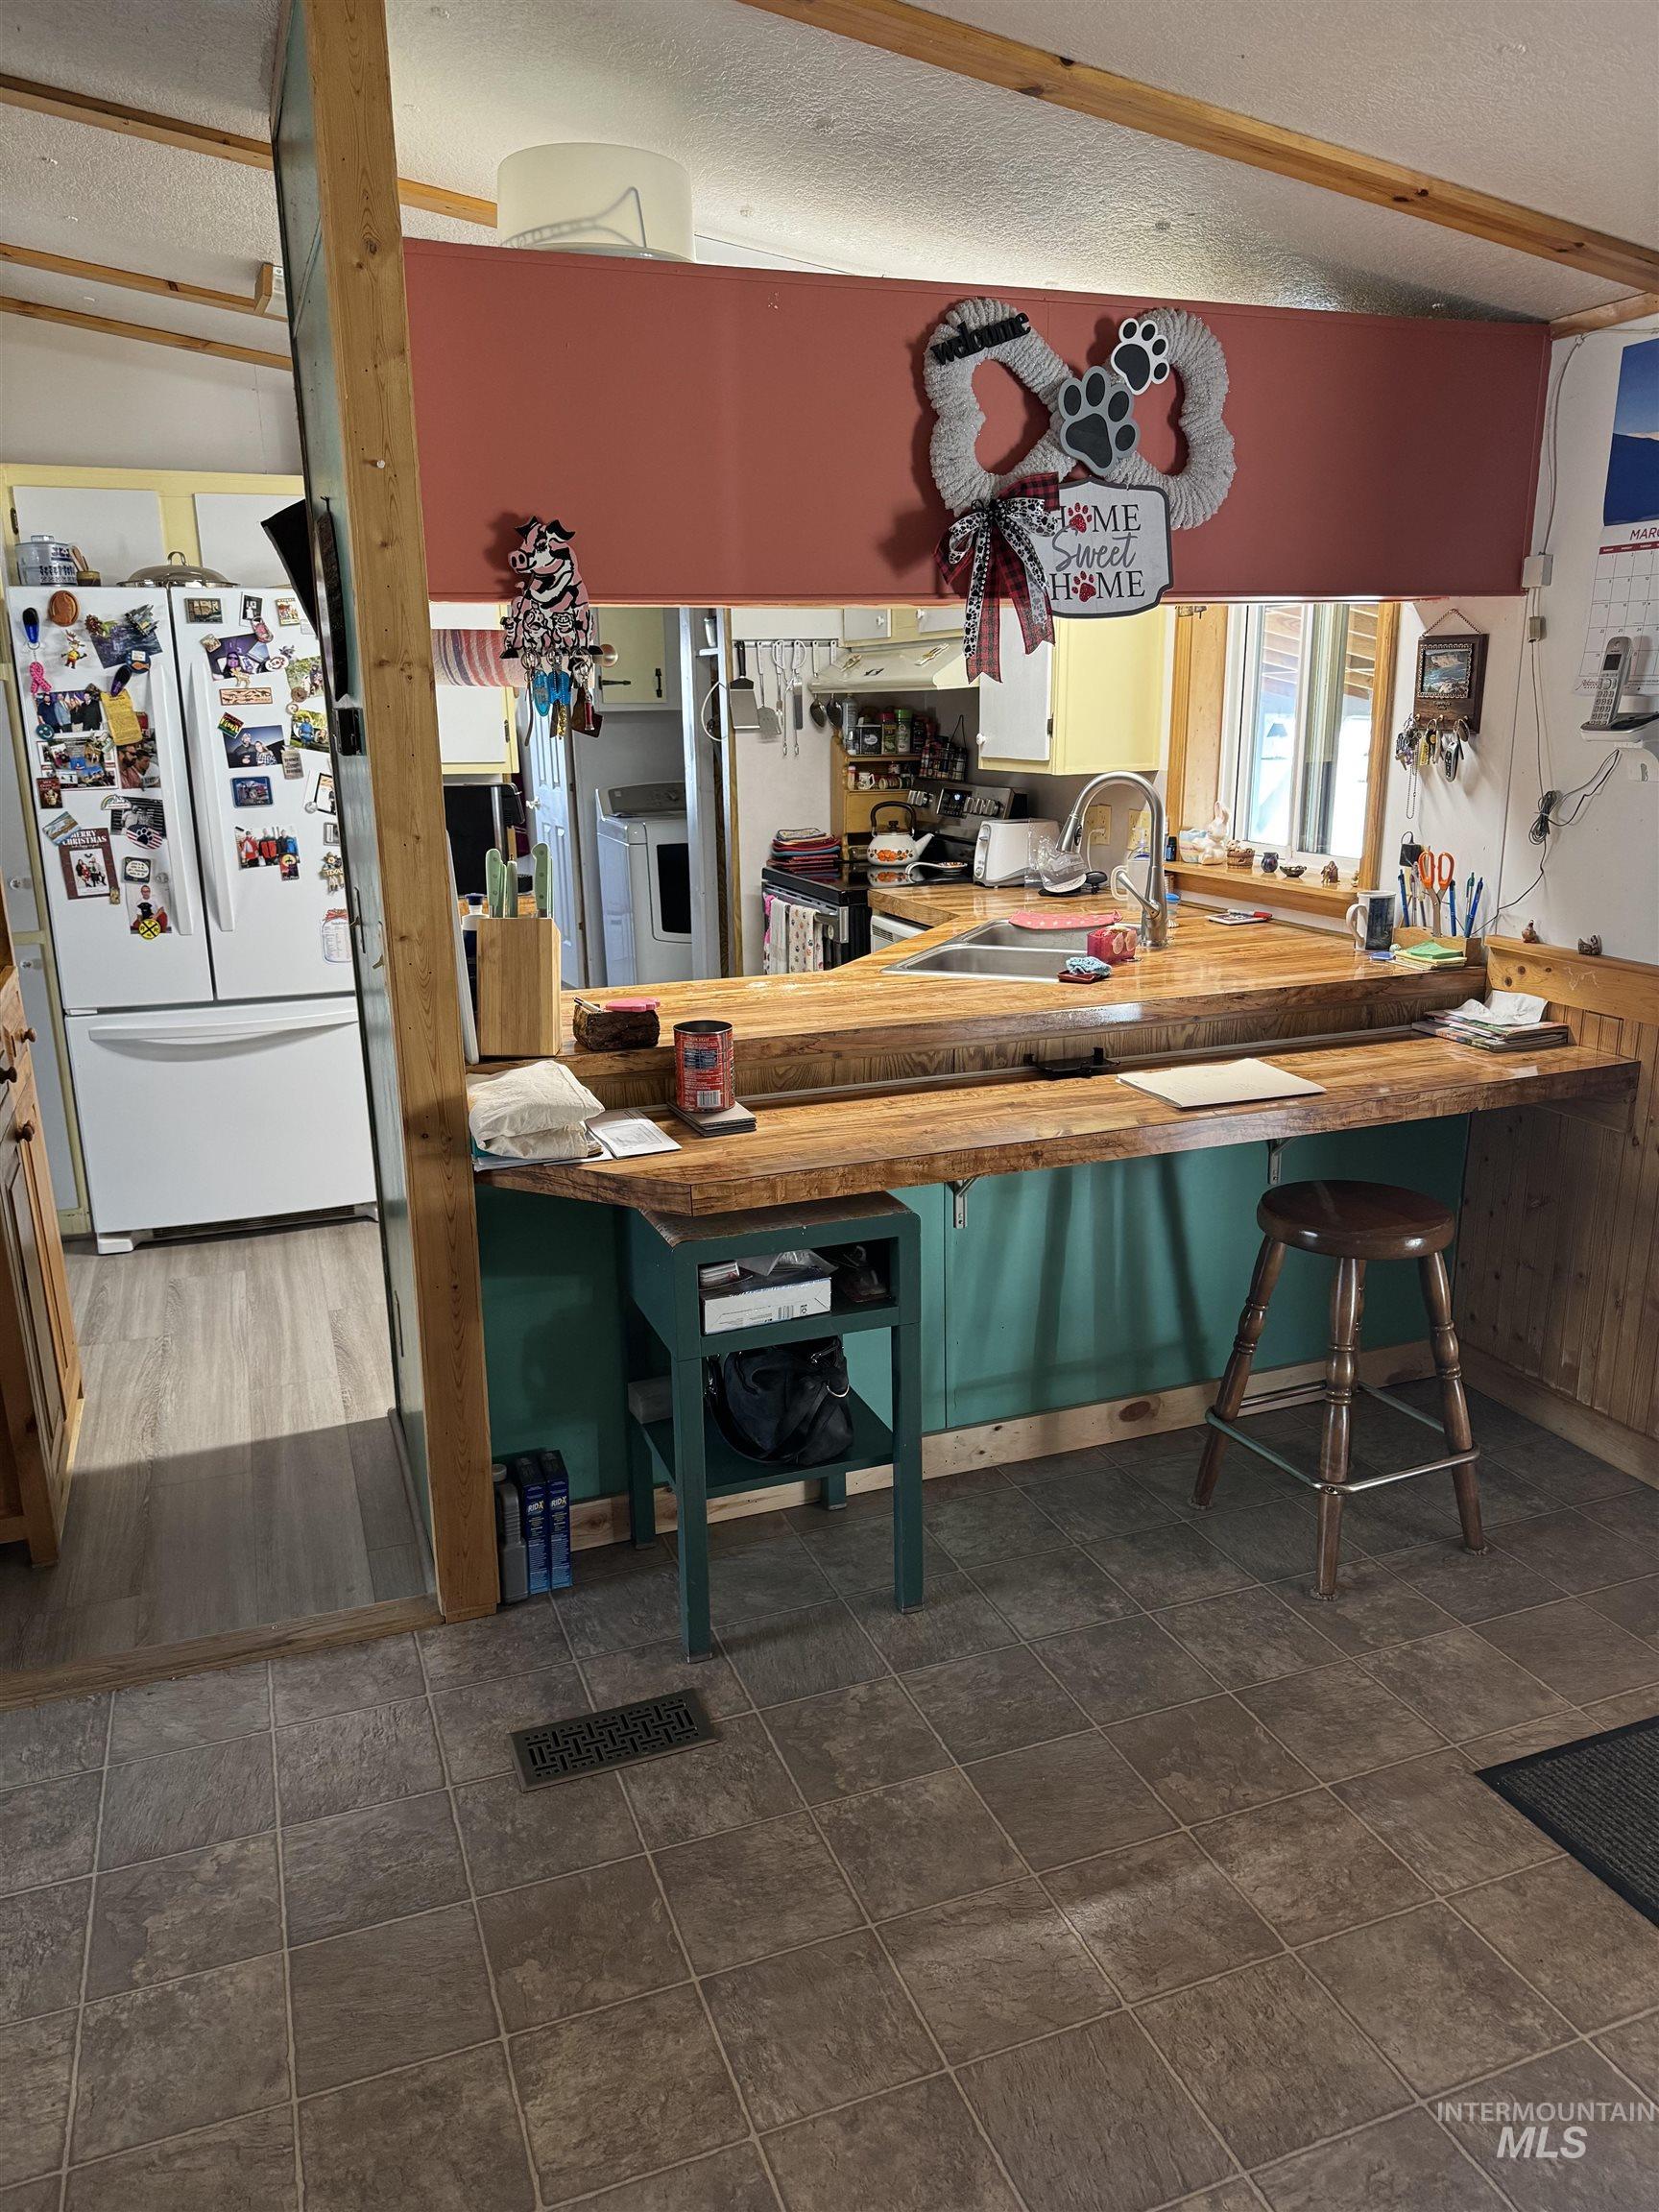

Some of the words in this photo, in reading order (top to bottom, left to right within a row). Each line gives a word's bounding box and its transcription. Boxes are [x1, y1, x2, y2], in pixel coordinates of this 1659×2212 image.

[930, 313, 1031, 365] welcome
[1052, 525, 1139, 571] Sweet
[1049, 570, 1145, 602] HOME
[62, 835, 107, 846] CHRISTMAS
